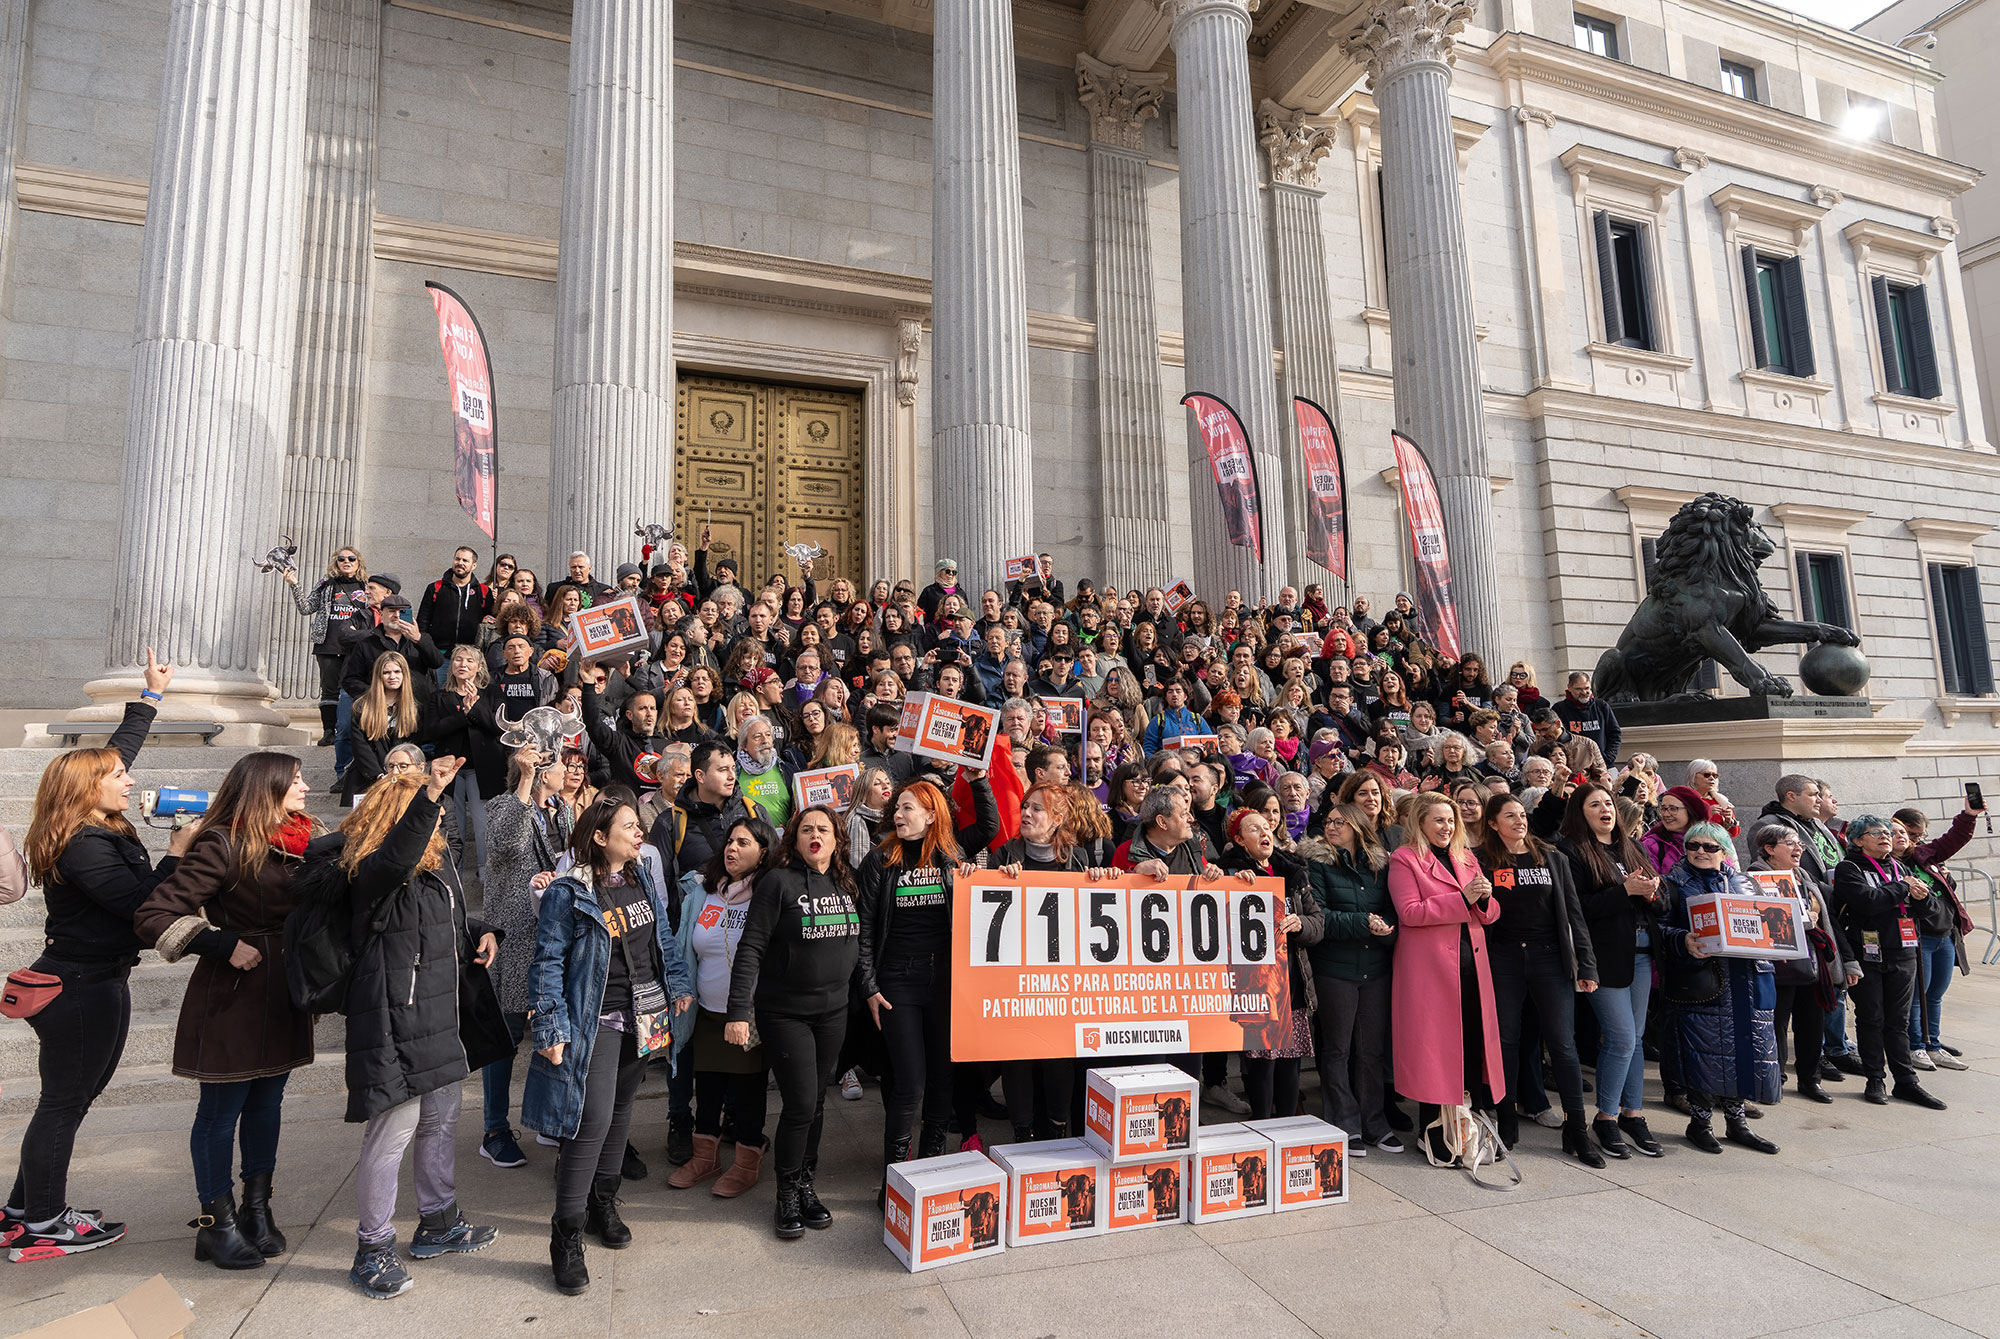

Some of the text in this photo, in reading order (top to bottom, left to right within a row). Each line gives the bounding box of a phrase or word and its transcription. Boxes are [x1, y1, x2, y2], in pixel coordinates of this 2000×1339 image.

[931, 727, 955, 740] CULTURA
[1518, 876, 1553, 886] CULTURA
[626, 899, 651, 917] NOES
[820, 925, 828, 933] LA
[982, 889, 1268, 963] 715606
[1733, 925, 1760, 935] CULTURA
[802, 930, 825, 939] TODOS
[825, 930, 836, 938] LOS
[1018, 971, 1237, 993] FIRMAS PARA DEROGAR LA LEY DE
[982, 993, 1269, 1018] PATRIMONIO CULTURAL DE LA TAUROMAQUIA
[1105, 1029, 1183, 1045] NOESMICULTURA
[1128, 1127, 1156, 1138] CULTURA
[1289, 1177, 1312, 1188] CULTURA
[1209, 1186, 1235, 1198] CULTURA
[1117, 1199, 1145, 1211] CULTURA
[1029, 1206, 1058, 1219] CULTURA
[931, 1227, 960, 1243] CULTURA
